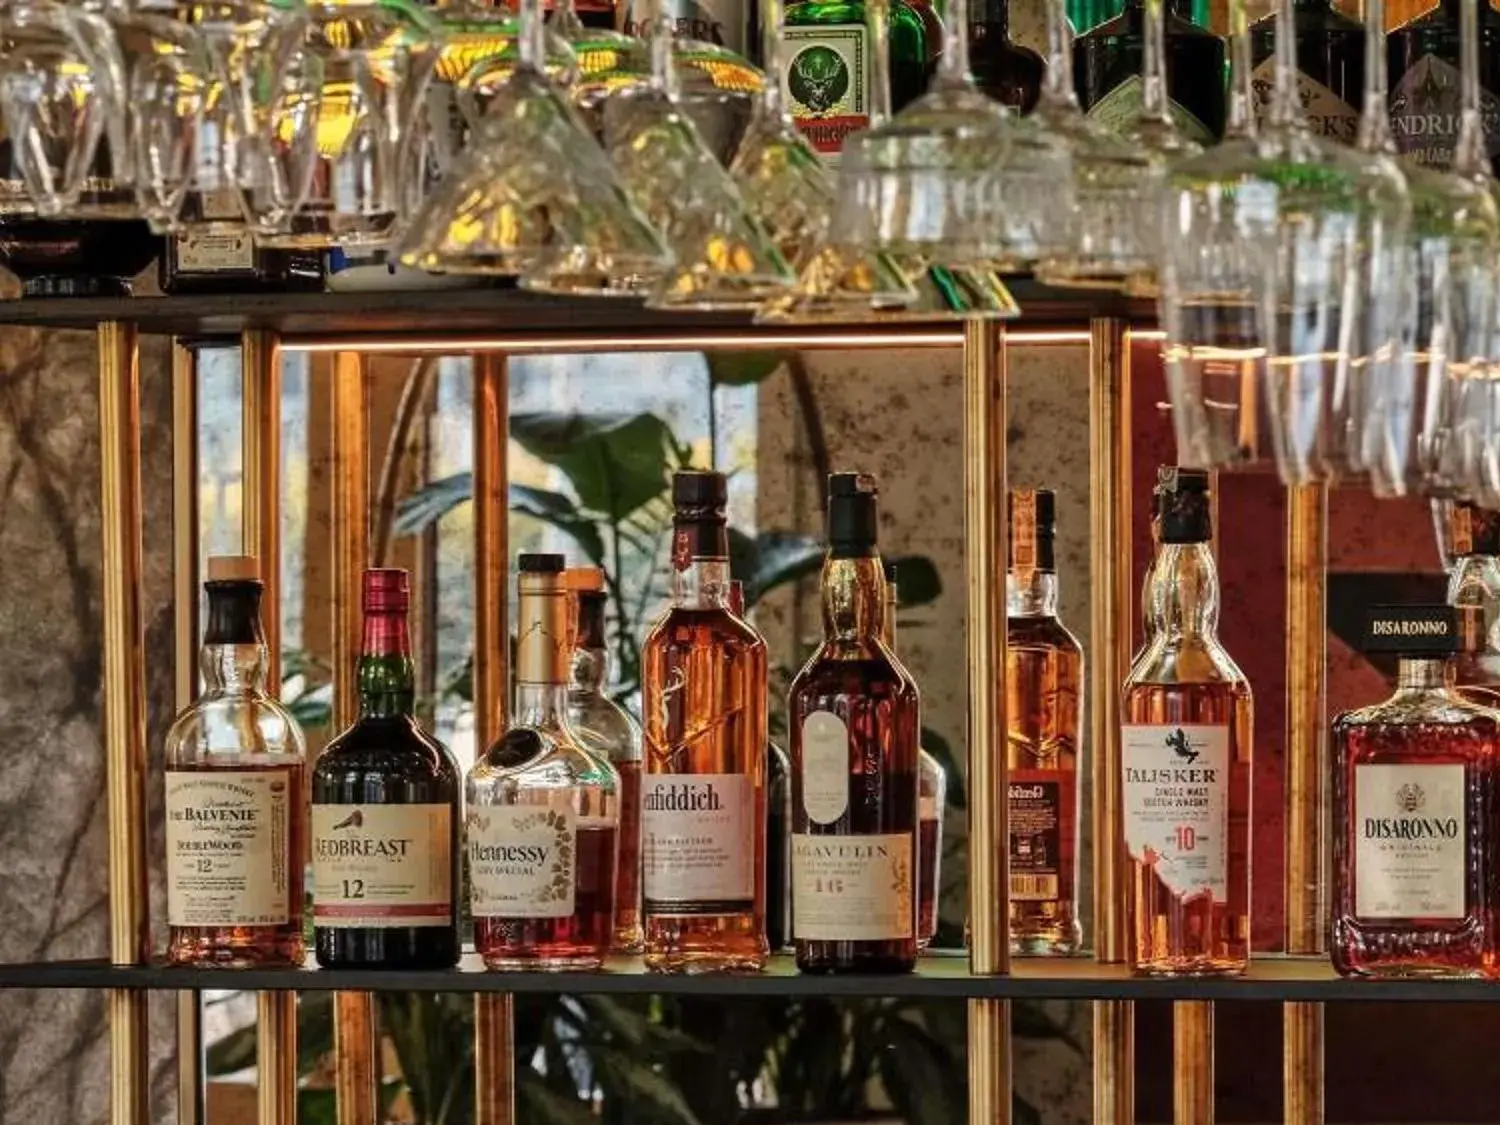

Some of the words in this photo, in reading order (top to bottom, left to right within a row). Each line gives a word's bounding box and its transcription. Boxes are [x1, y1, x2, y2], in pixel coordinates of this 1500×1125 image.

[1372, 619, 1448, 636] DISARONNO
[1125, 767, 1217, 783] TALISKER
[184, 807, 257, 821] BALVENIE
[1364, 816, 1458, 839] DISARONNO
[1175, 825, 1196, 851] 10
[197, 859, 214, 873] 12
[341, 879, 365, 898] 12
